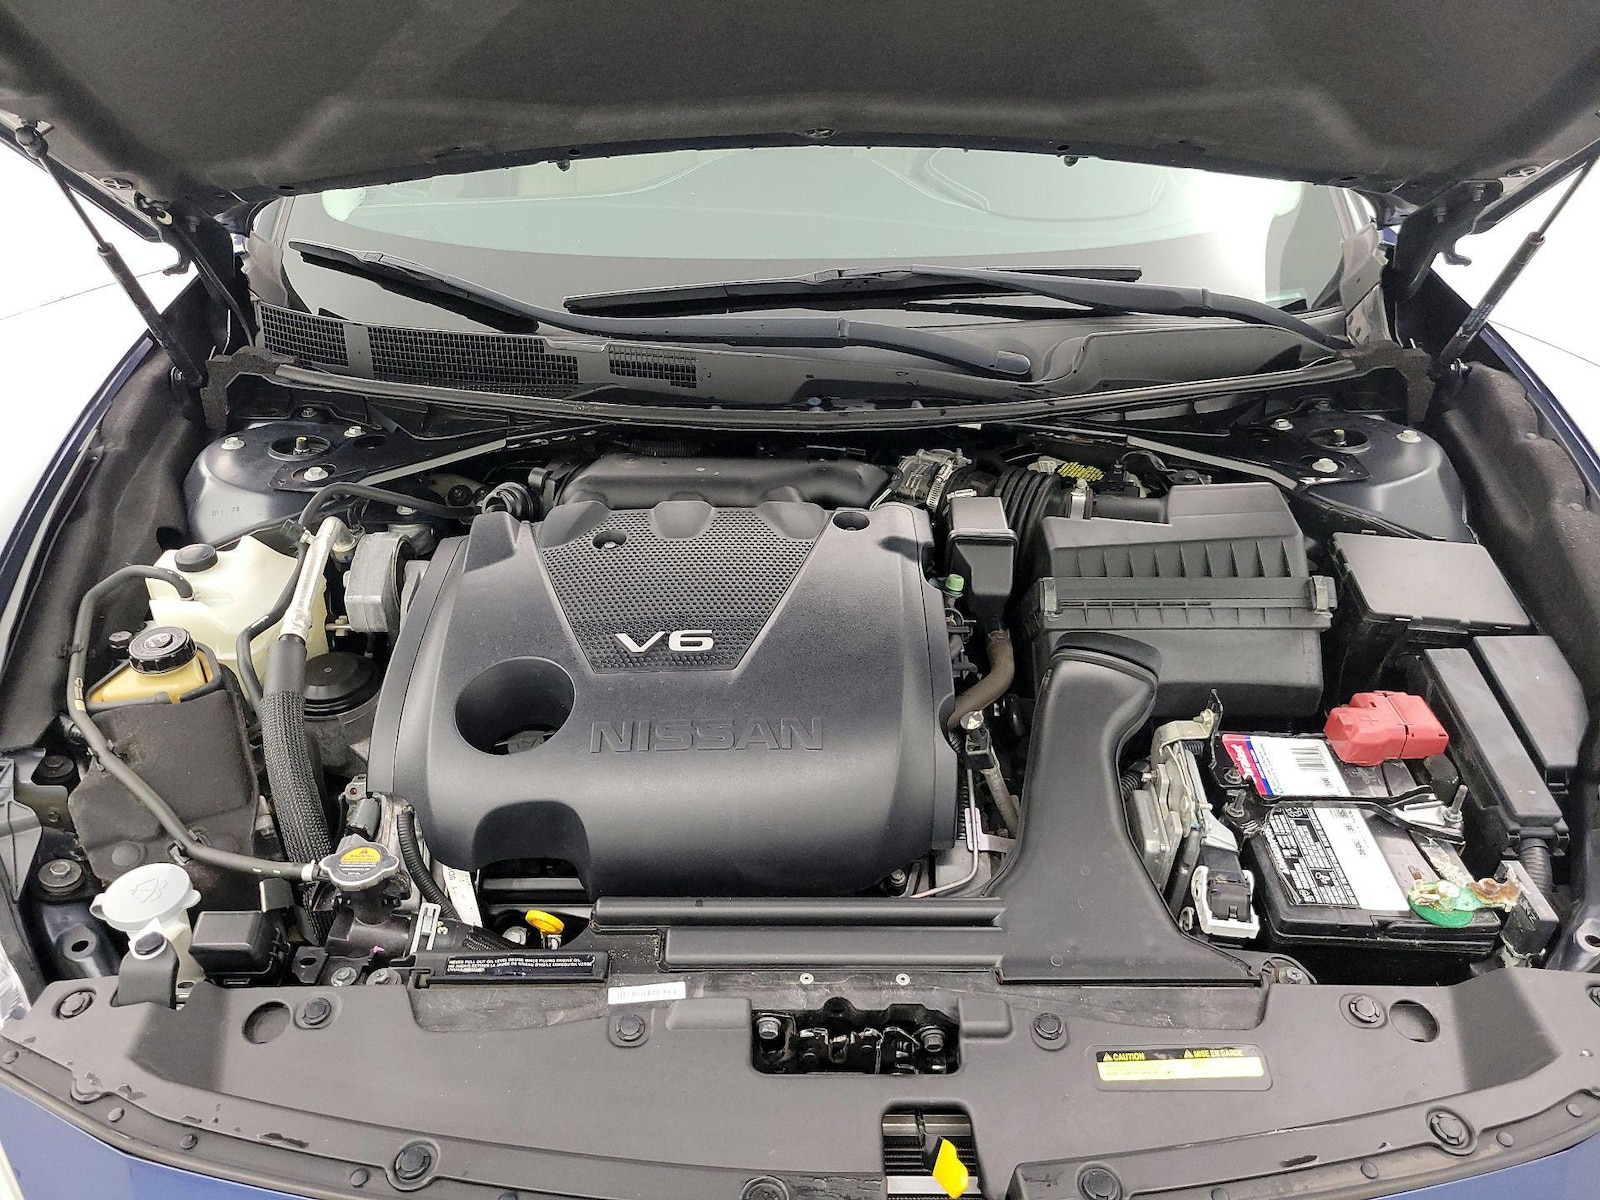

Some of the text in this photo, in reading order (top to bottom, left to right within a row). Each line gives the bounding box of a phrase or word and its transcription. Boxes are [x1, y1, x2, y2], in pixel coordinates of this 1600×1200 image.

[614, 629, 715, 654] V6
[589, 717, 824, 754] NISSAN
[1112, 1052, 1146, 1061] CAUTION
[1193, 1049, 1244, 1058] MISE EN GARDE
